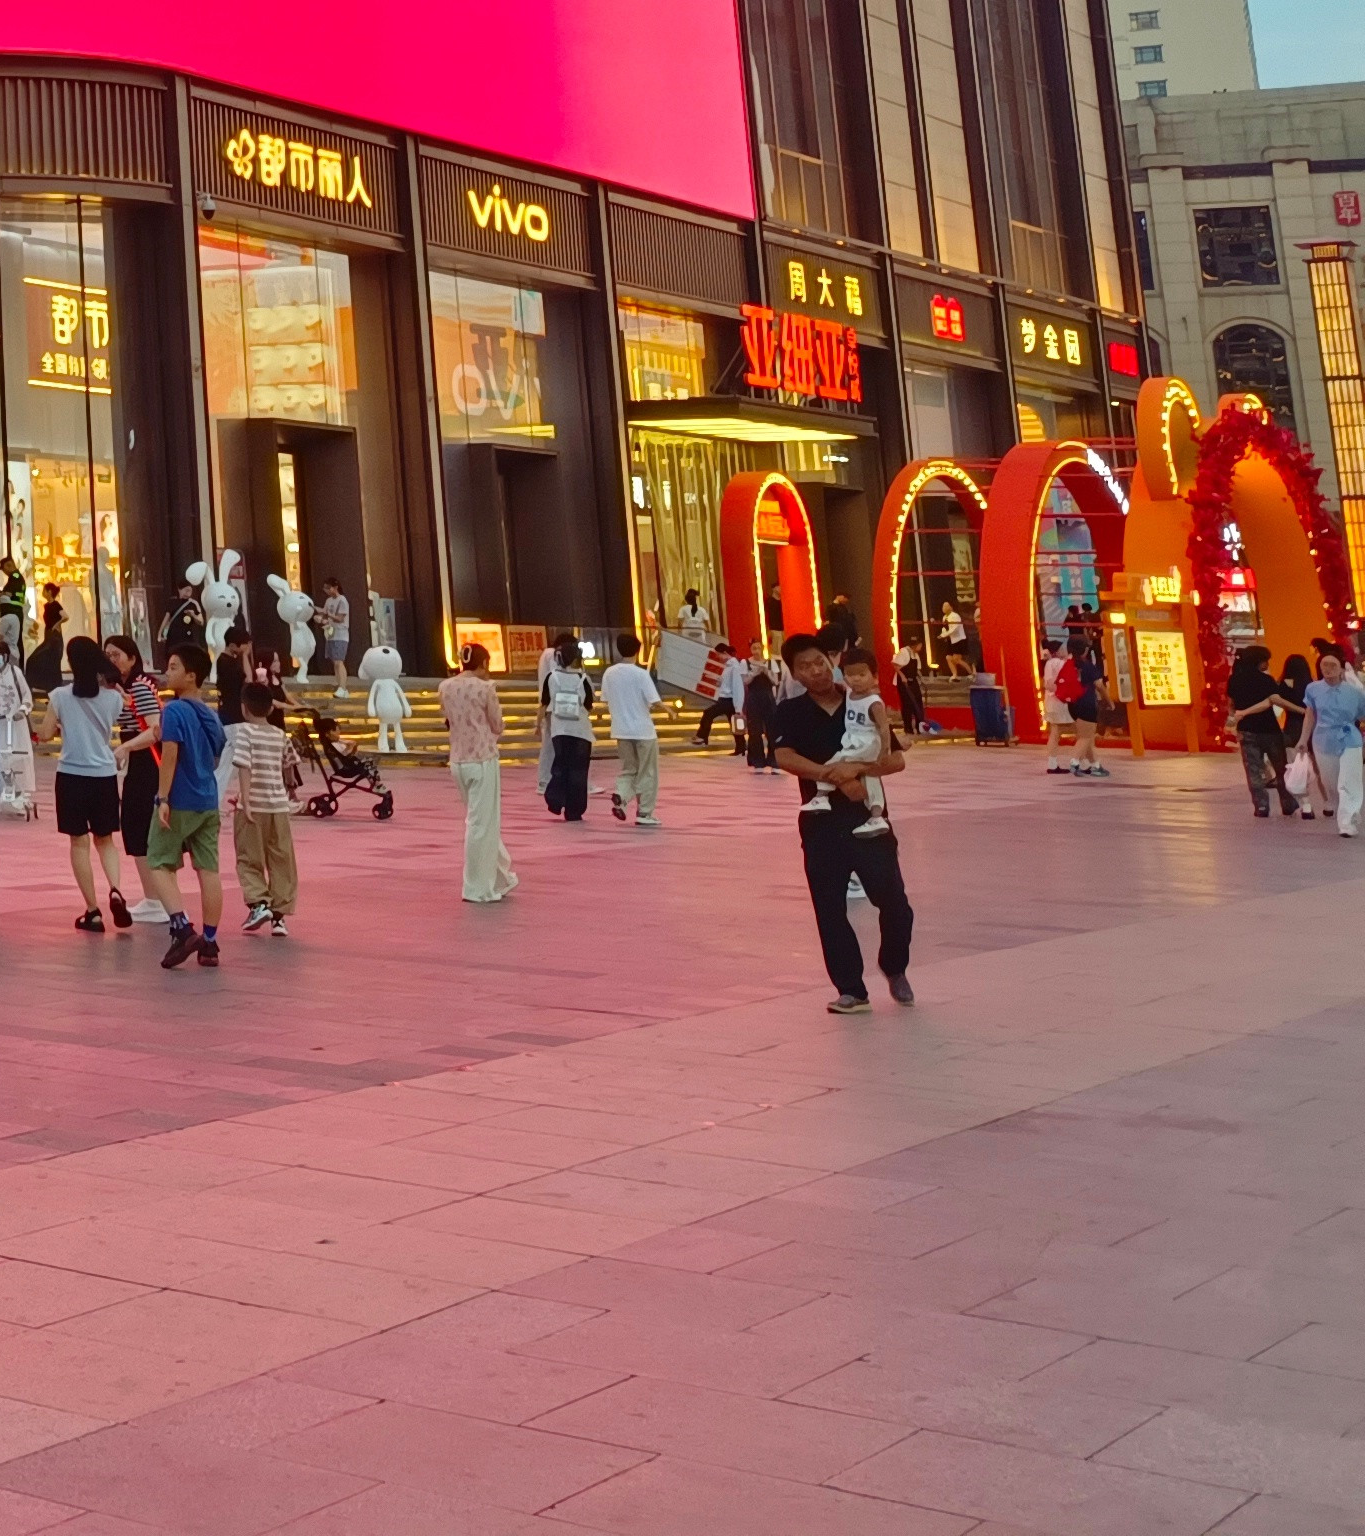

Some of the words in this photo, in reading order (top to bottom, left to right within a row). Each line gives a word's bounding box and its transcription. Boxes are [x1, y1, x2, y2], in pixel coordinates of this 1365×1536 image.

[257, 133, 372, 209] 都市丽人
[467, 184, 550, 242] vivo
[788, 261, 864, 316] 周大福
[51, 294, 110, 349] 都市
[1020, 318, 1081, 366] 梦金园
[741, 304, 848, 401] 亚细亚
